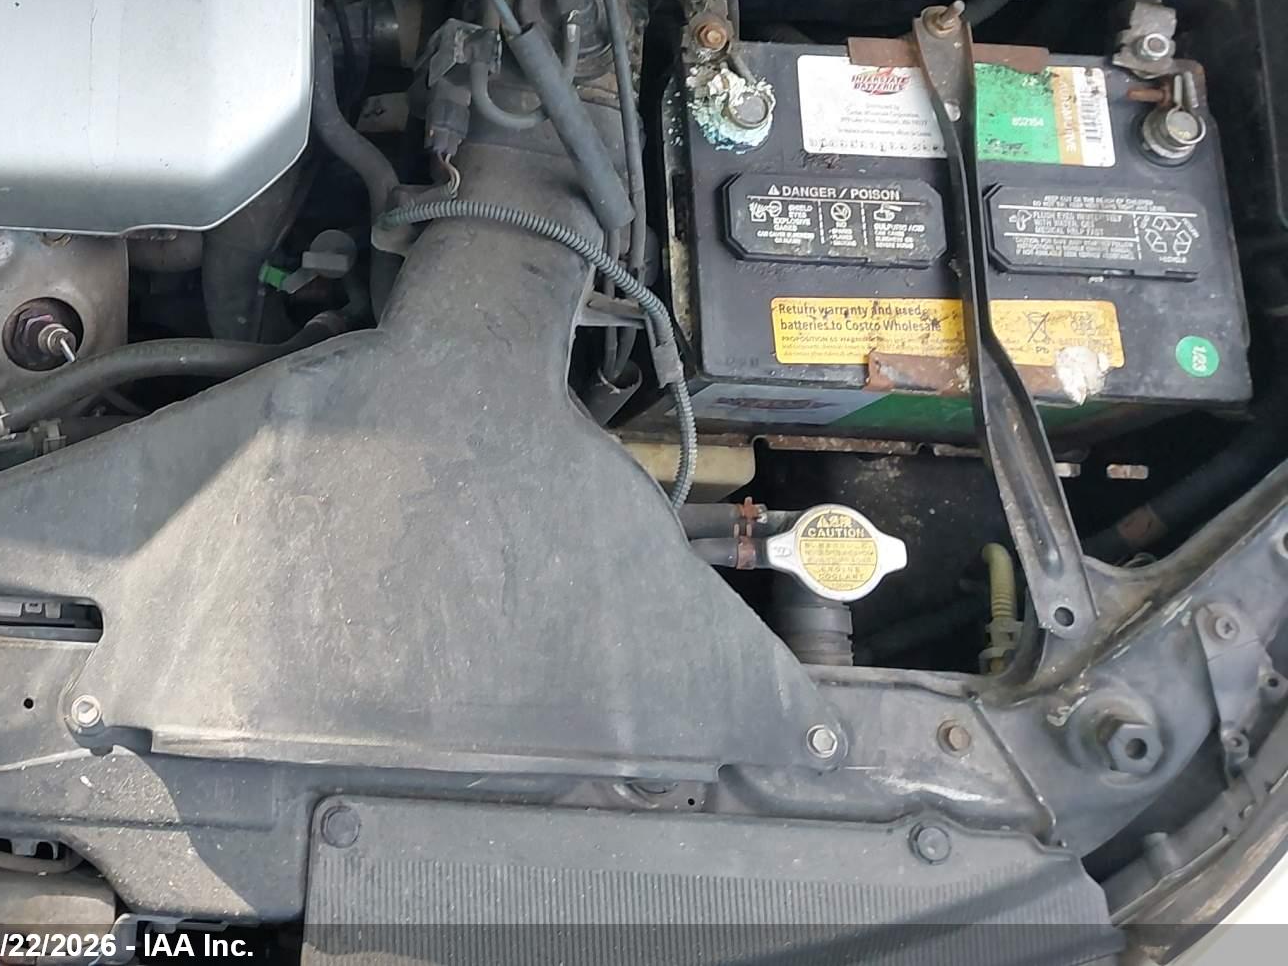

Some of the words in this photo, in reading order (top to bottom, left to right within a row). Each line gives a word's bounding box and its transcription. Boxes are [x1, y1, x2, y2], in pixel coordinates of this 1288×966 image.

[781, 185, 837, 199] DANGER
[850, 187, 901, 201] POISON
[778, 303, 815, 315] Return
[818, 304, 869, 319] warranty
[895, 304, 922, 316] used
[780, 319, 828, 331] batteries
[831, 320, 842, 331] to
[845, 320, 881, 332] Costco
[807, 528, 865, 538] CAUTION
